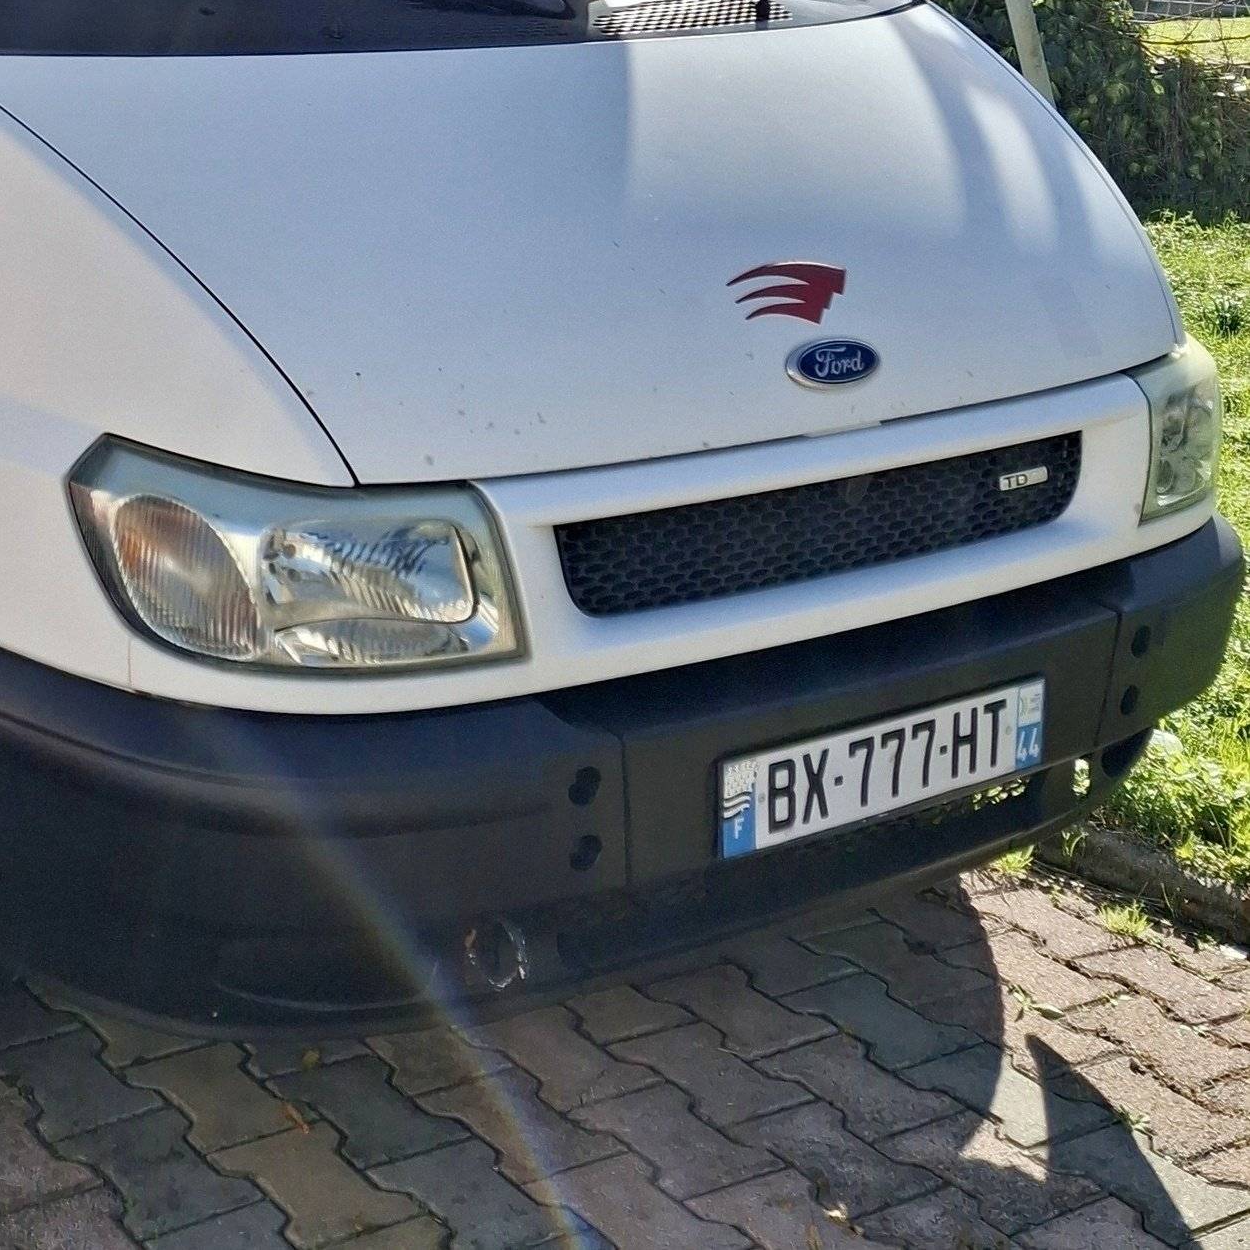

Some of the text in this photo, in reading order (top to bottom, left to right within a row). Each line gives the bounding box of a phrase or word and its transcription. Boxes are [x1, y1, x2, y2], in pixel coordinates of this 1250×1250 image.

[814, 346, 864, 378] Ford
[733, 816, 746, 840] F
[767, 699, 1008, 835] BX-777-HT
[1016, 727, 1041, 762] 44
